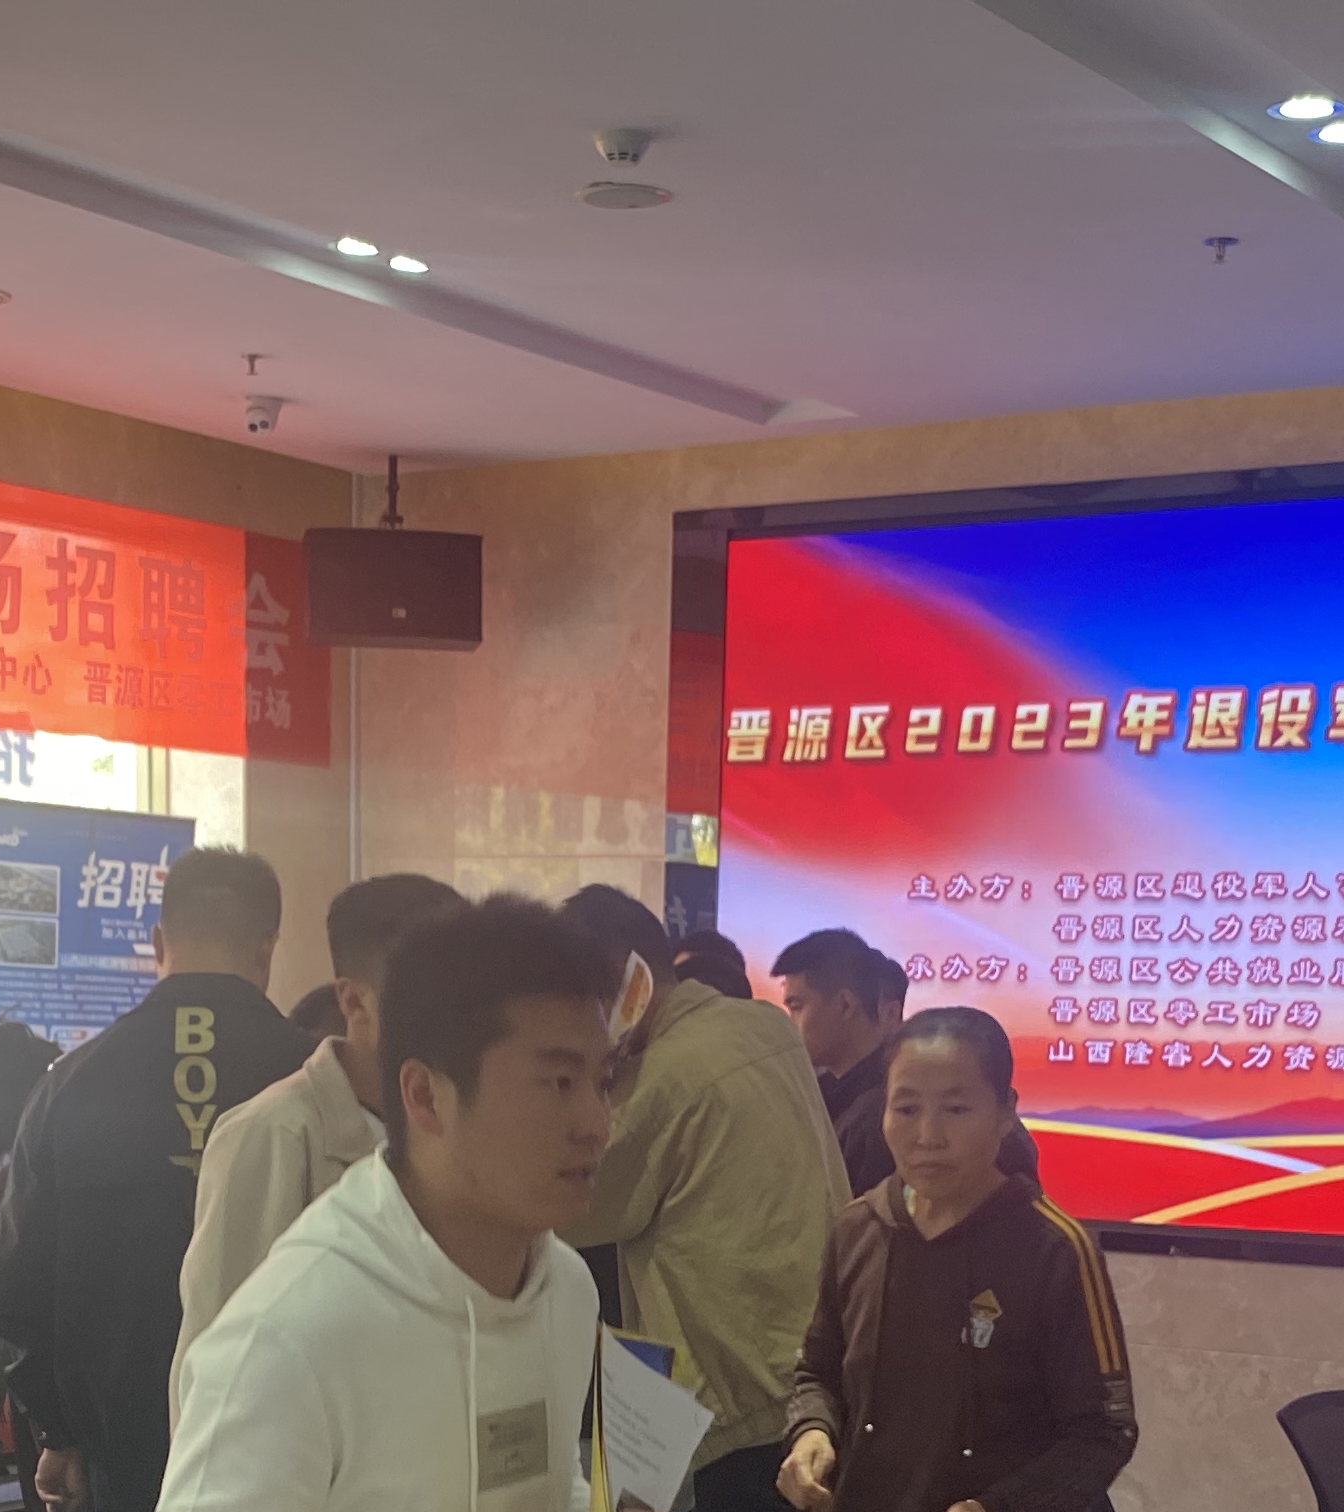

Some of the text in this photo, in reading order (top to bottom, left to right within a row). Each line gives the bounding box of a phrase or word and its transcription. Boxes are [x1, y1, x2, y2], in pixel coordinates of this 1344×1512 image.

[1050, 998, 1322, 1029] 晋源区零工市场
[173, 1006, 218, 1150] BOY
